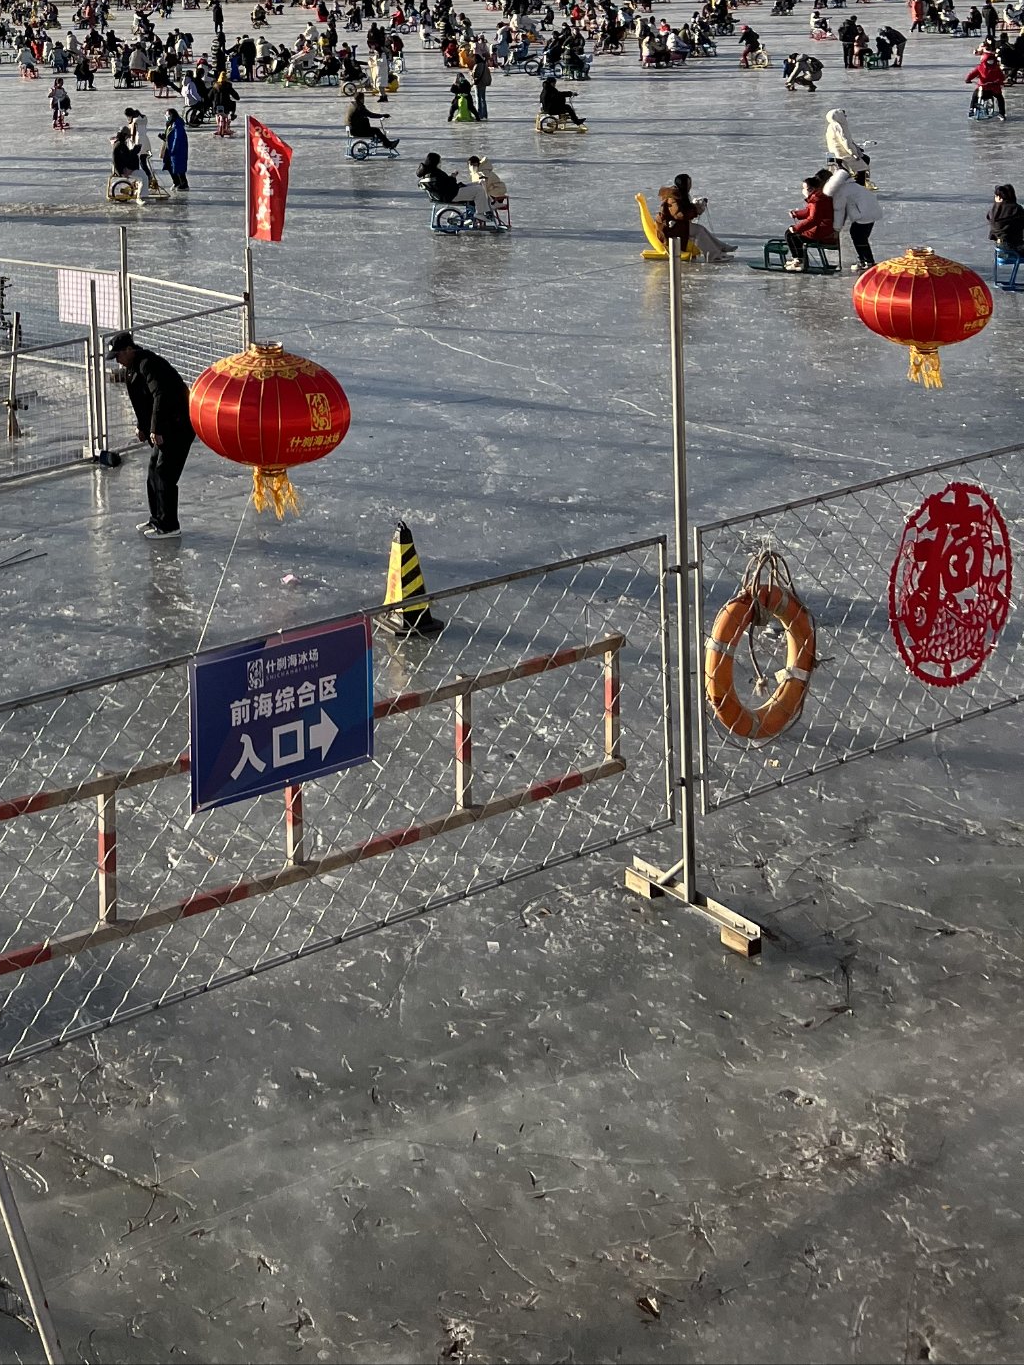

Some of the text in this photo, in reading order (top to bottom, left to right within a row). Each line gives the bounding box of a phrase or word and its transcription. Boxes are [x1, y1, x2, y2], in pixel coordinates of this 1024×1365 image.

[266, 648, 319, 674] 什刹海冰场
[230, 674, 338, 727] 前海综合区
[230, 719, 305, 781] 入口
